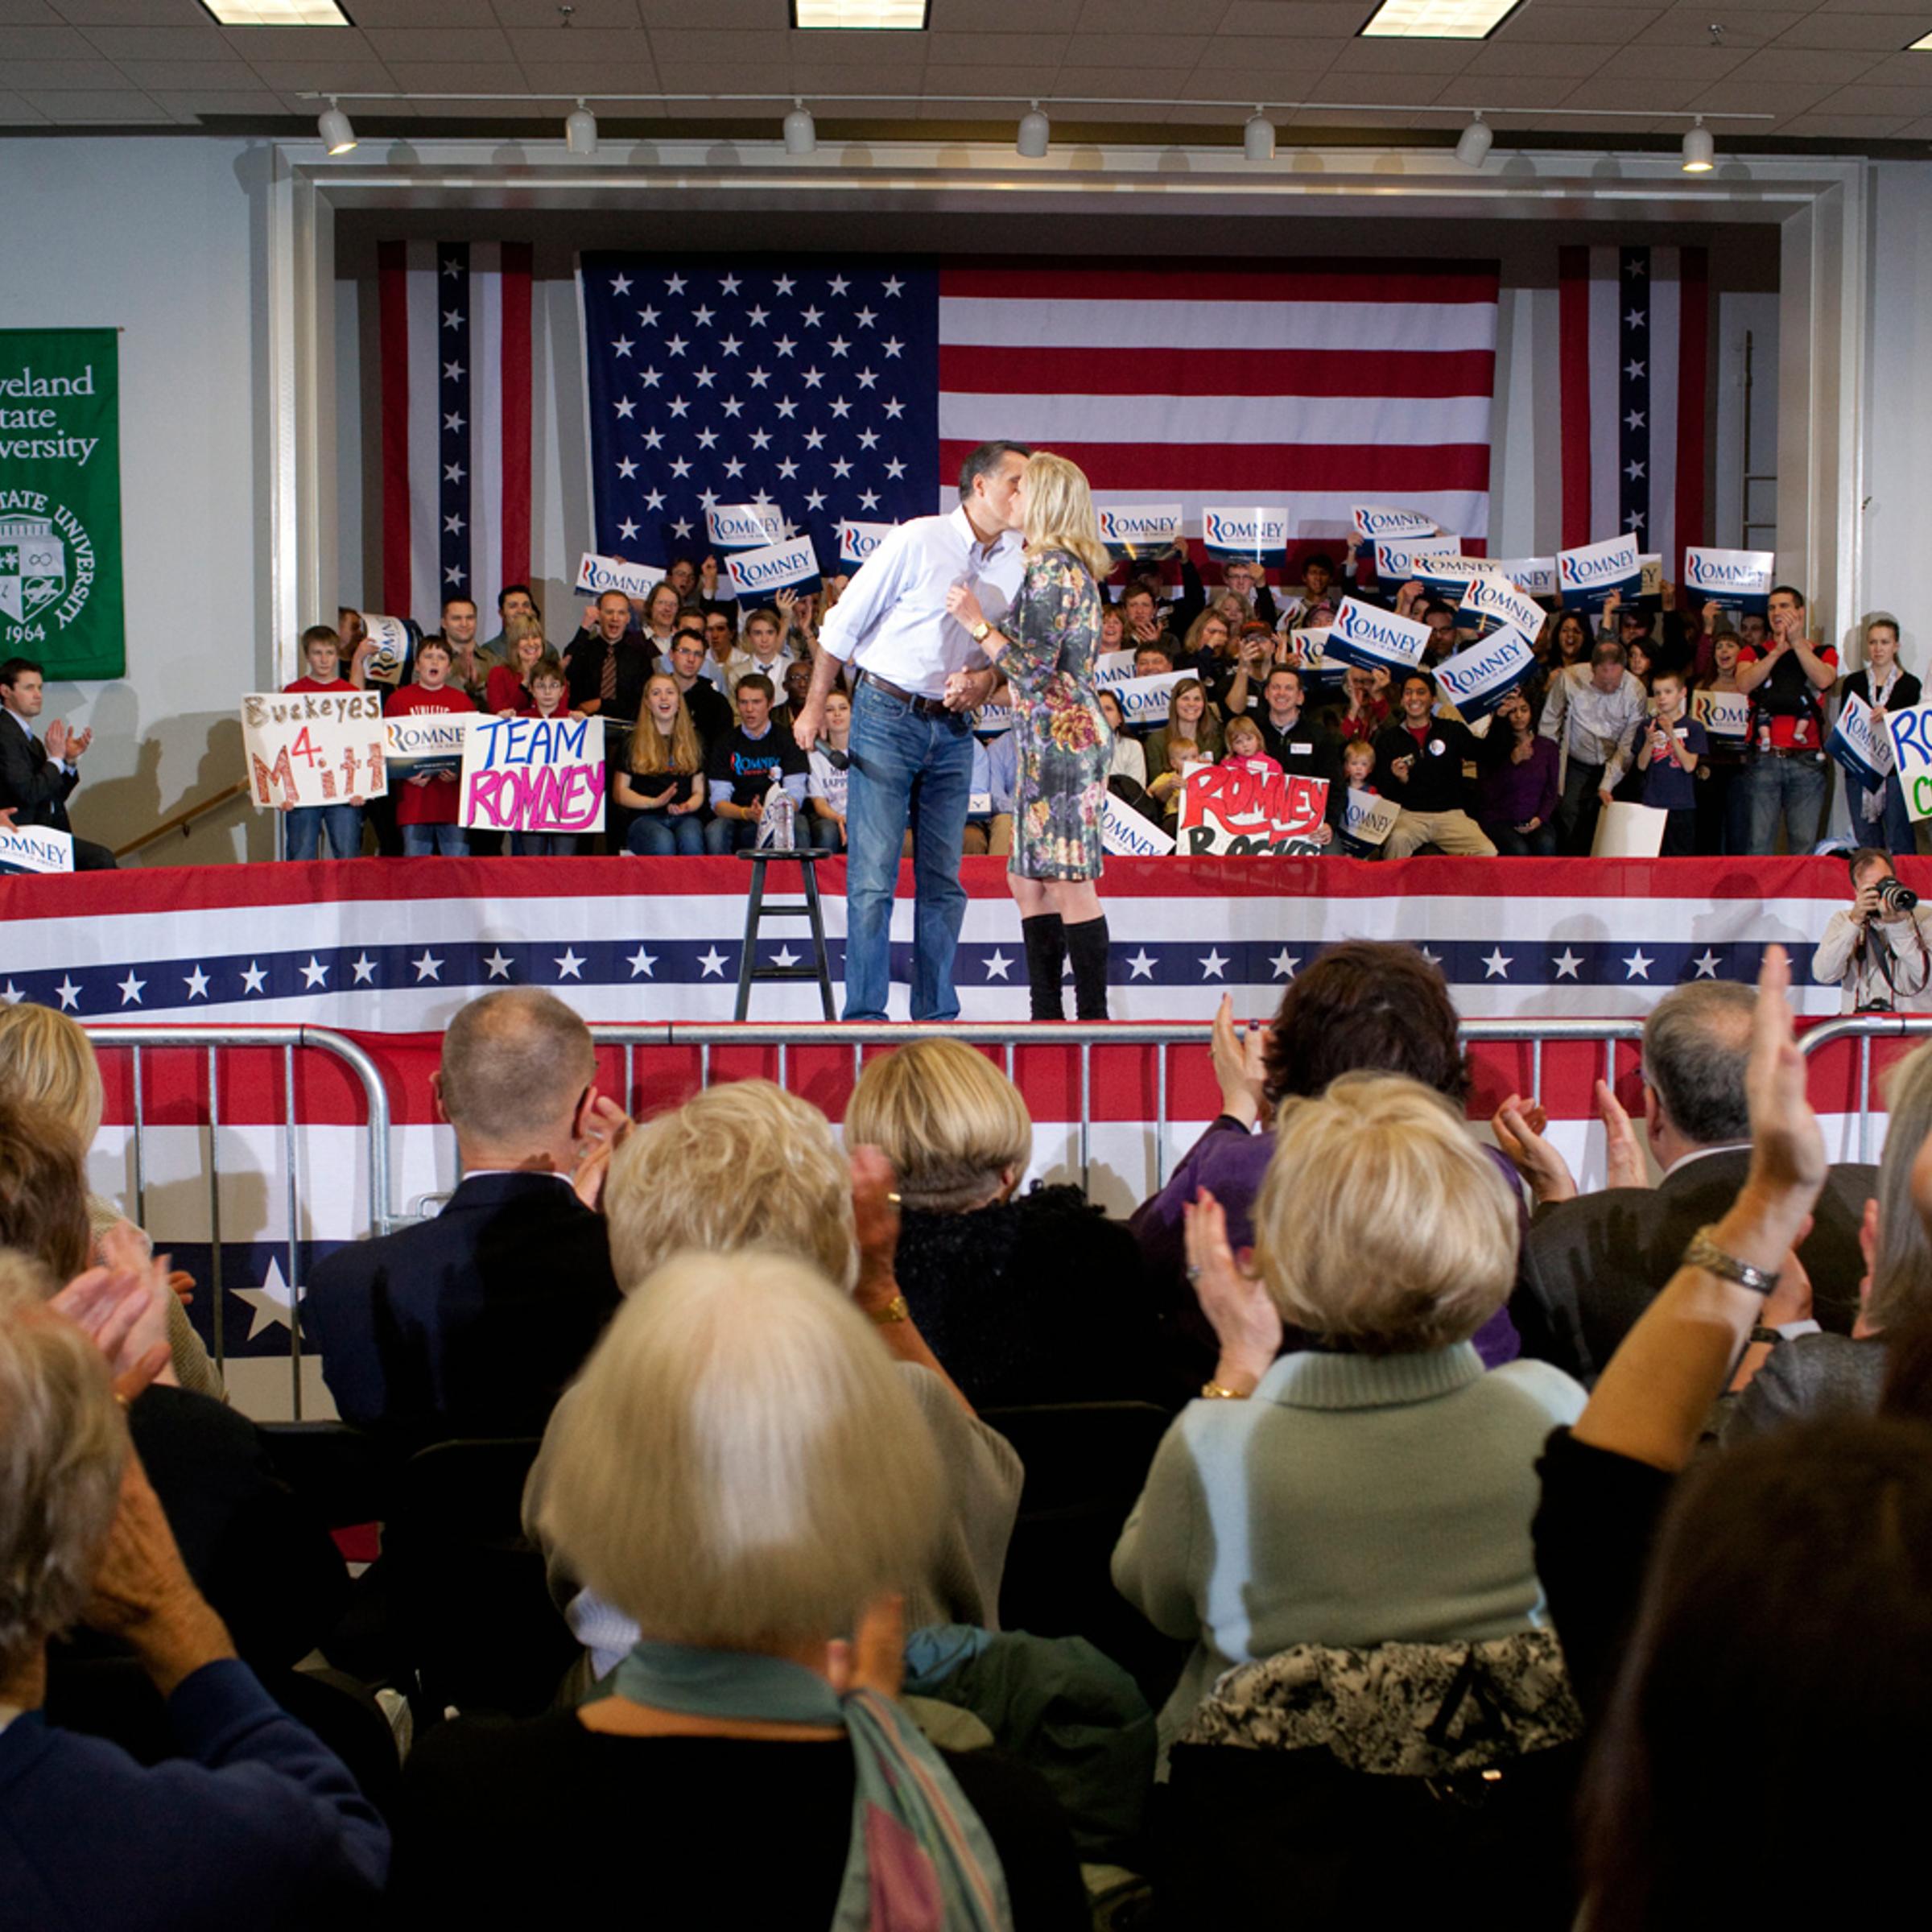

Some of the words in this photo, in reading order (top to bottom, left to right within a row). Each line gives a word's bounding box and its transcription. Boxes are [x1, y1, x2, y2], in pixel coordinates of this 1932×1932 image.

[845, 528, 881, 557] RO
[1100, 512, 1178, 539] ROMNEY
[1207, 513, 1284, 543] ROMNEY
[54, 504, 95, 630] UNIVERSITY
[729, 550, 809, 588] ROMNEY
[1562, 548, 1635, 584] ROMNEY
[1467, 579, 1539, 630] ROMNEY
[5, 623, 46, 644] 1964
[1339, 604, 1422, 654] ROMNEY
[1439, 638, 1521, 694] ROMNEY
[244, 695, 380, 728] Buckeyes
[291, 726, 323, 768] 4
[477, 719, 588, 771] TEAM
[252, 742, 385, 804] Mitt
[467, 760, 605, 831] ROMNEY
[1180, 766, 1330, 847] ROMNEY
